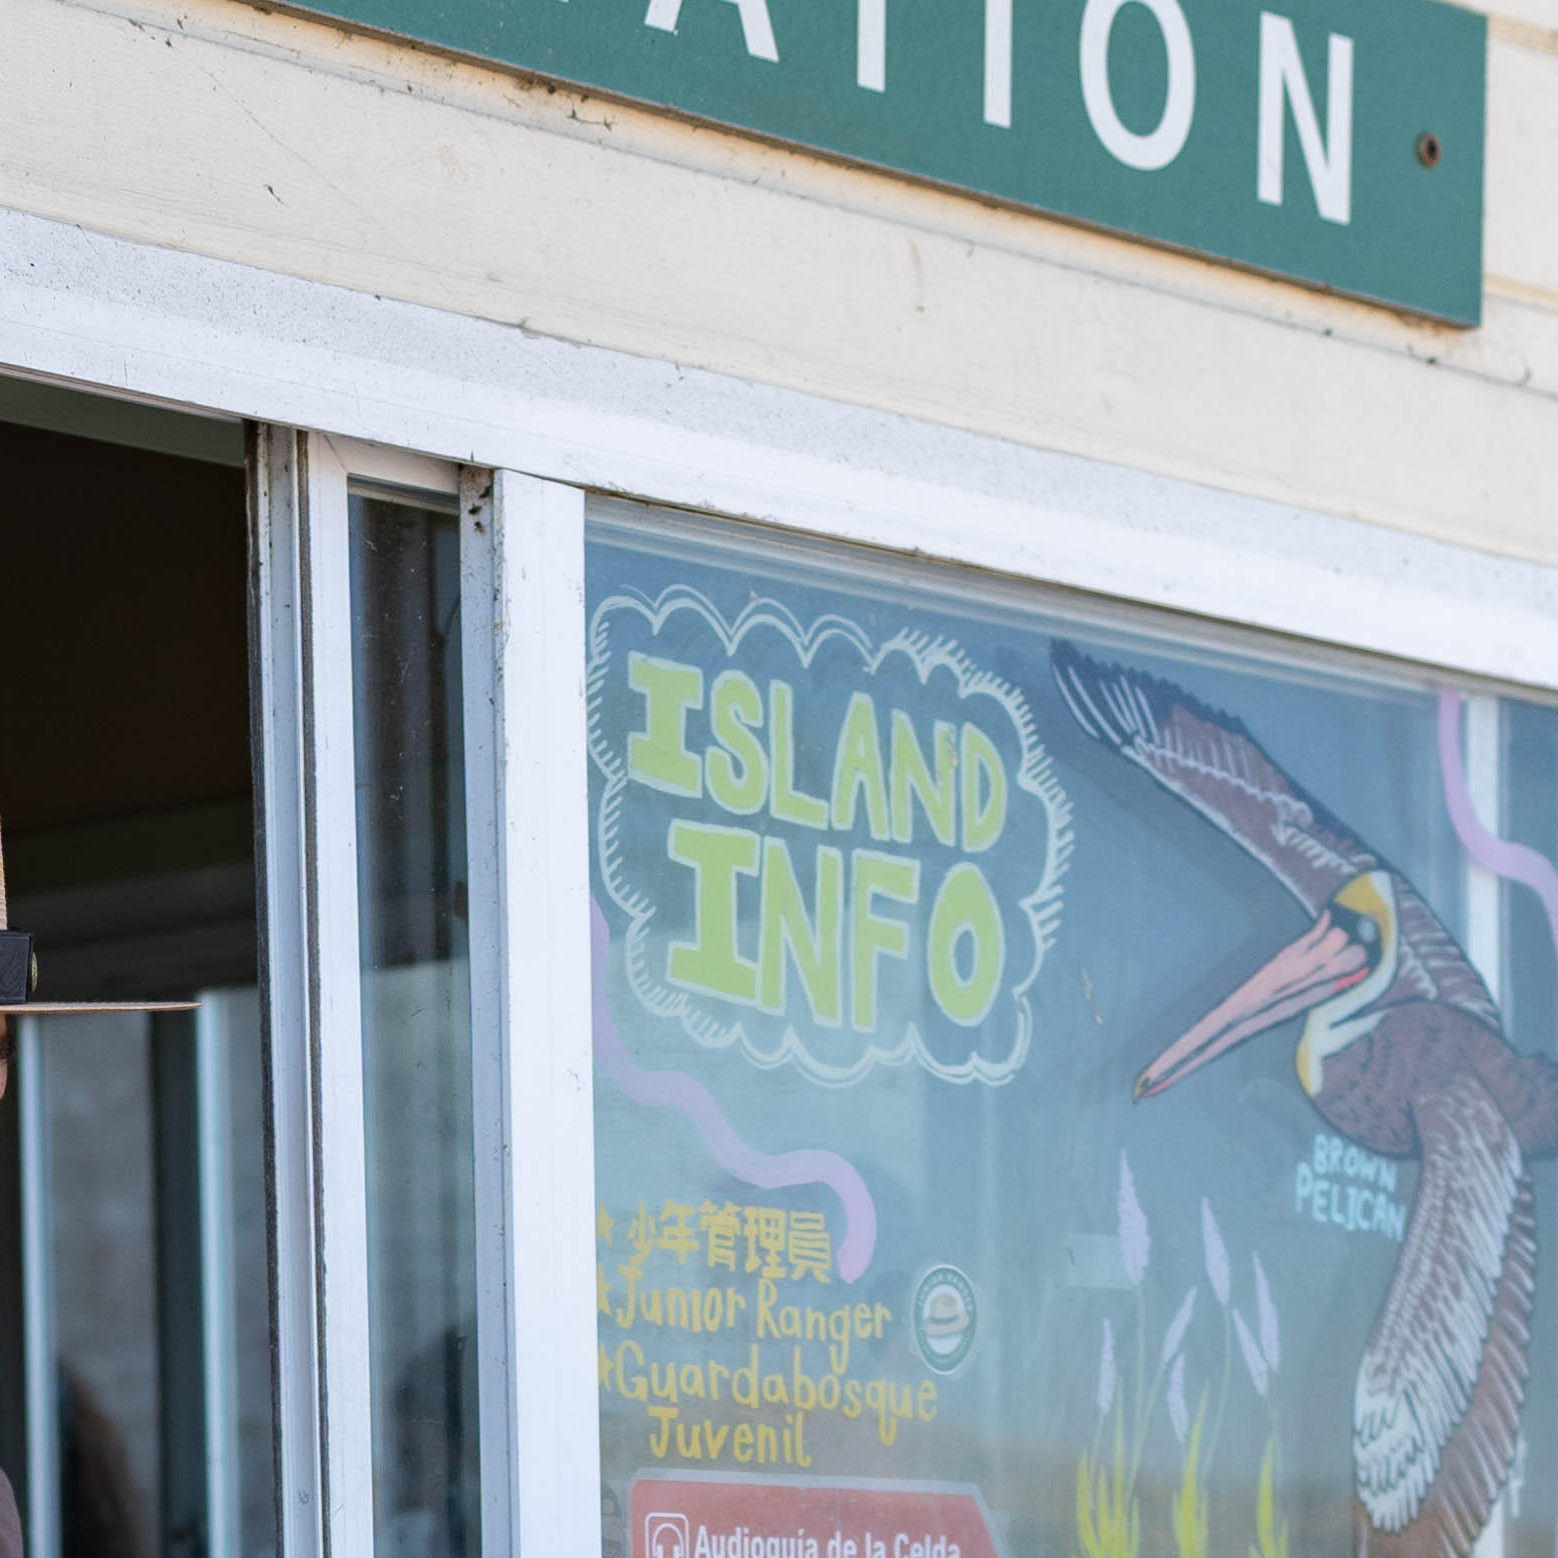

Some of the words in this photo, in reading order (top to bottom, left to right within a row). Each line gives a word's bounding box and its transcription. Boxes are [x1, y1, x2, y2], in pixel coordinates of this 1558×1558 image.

[627, 651, 1007, 853] ISLAND
[666, 818, 1006, 1033] INFO
[1295, 1161, 1408, 1243] PELICAN
[1313, 1133, 1398, 1193] BROWN
[627, 1197, 832, 1284] 少年管理員
[615, 1264, 746, 1333] Junior
[756, 1279, 892, 1374] Ranger
[616, 1340, 938, 1446] Guardabosque
[647, 1406, 812, 1467] Juvenil
